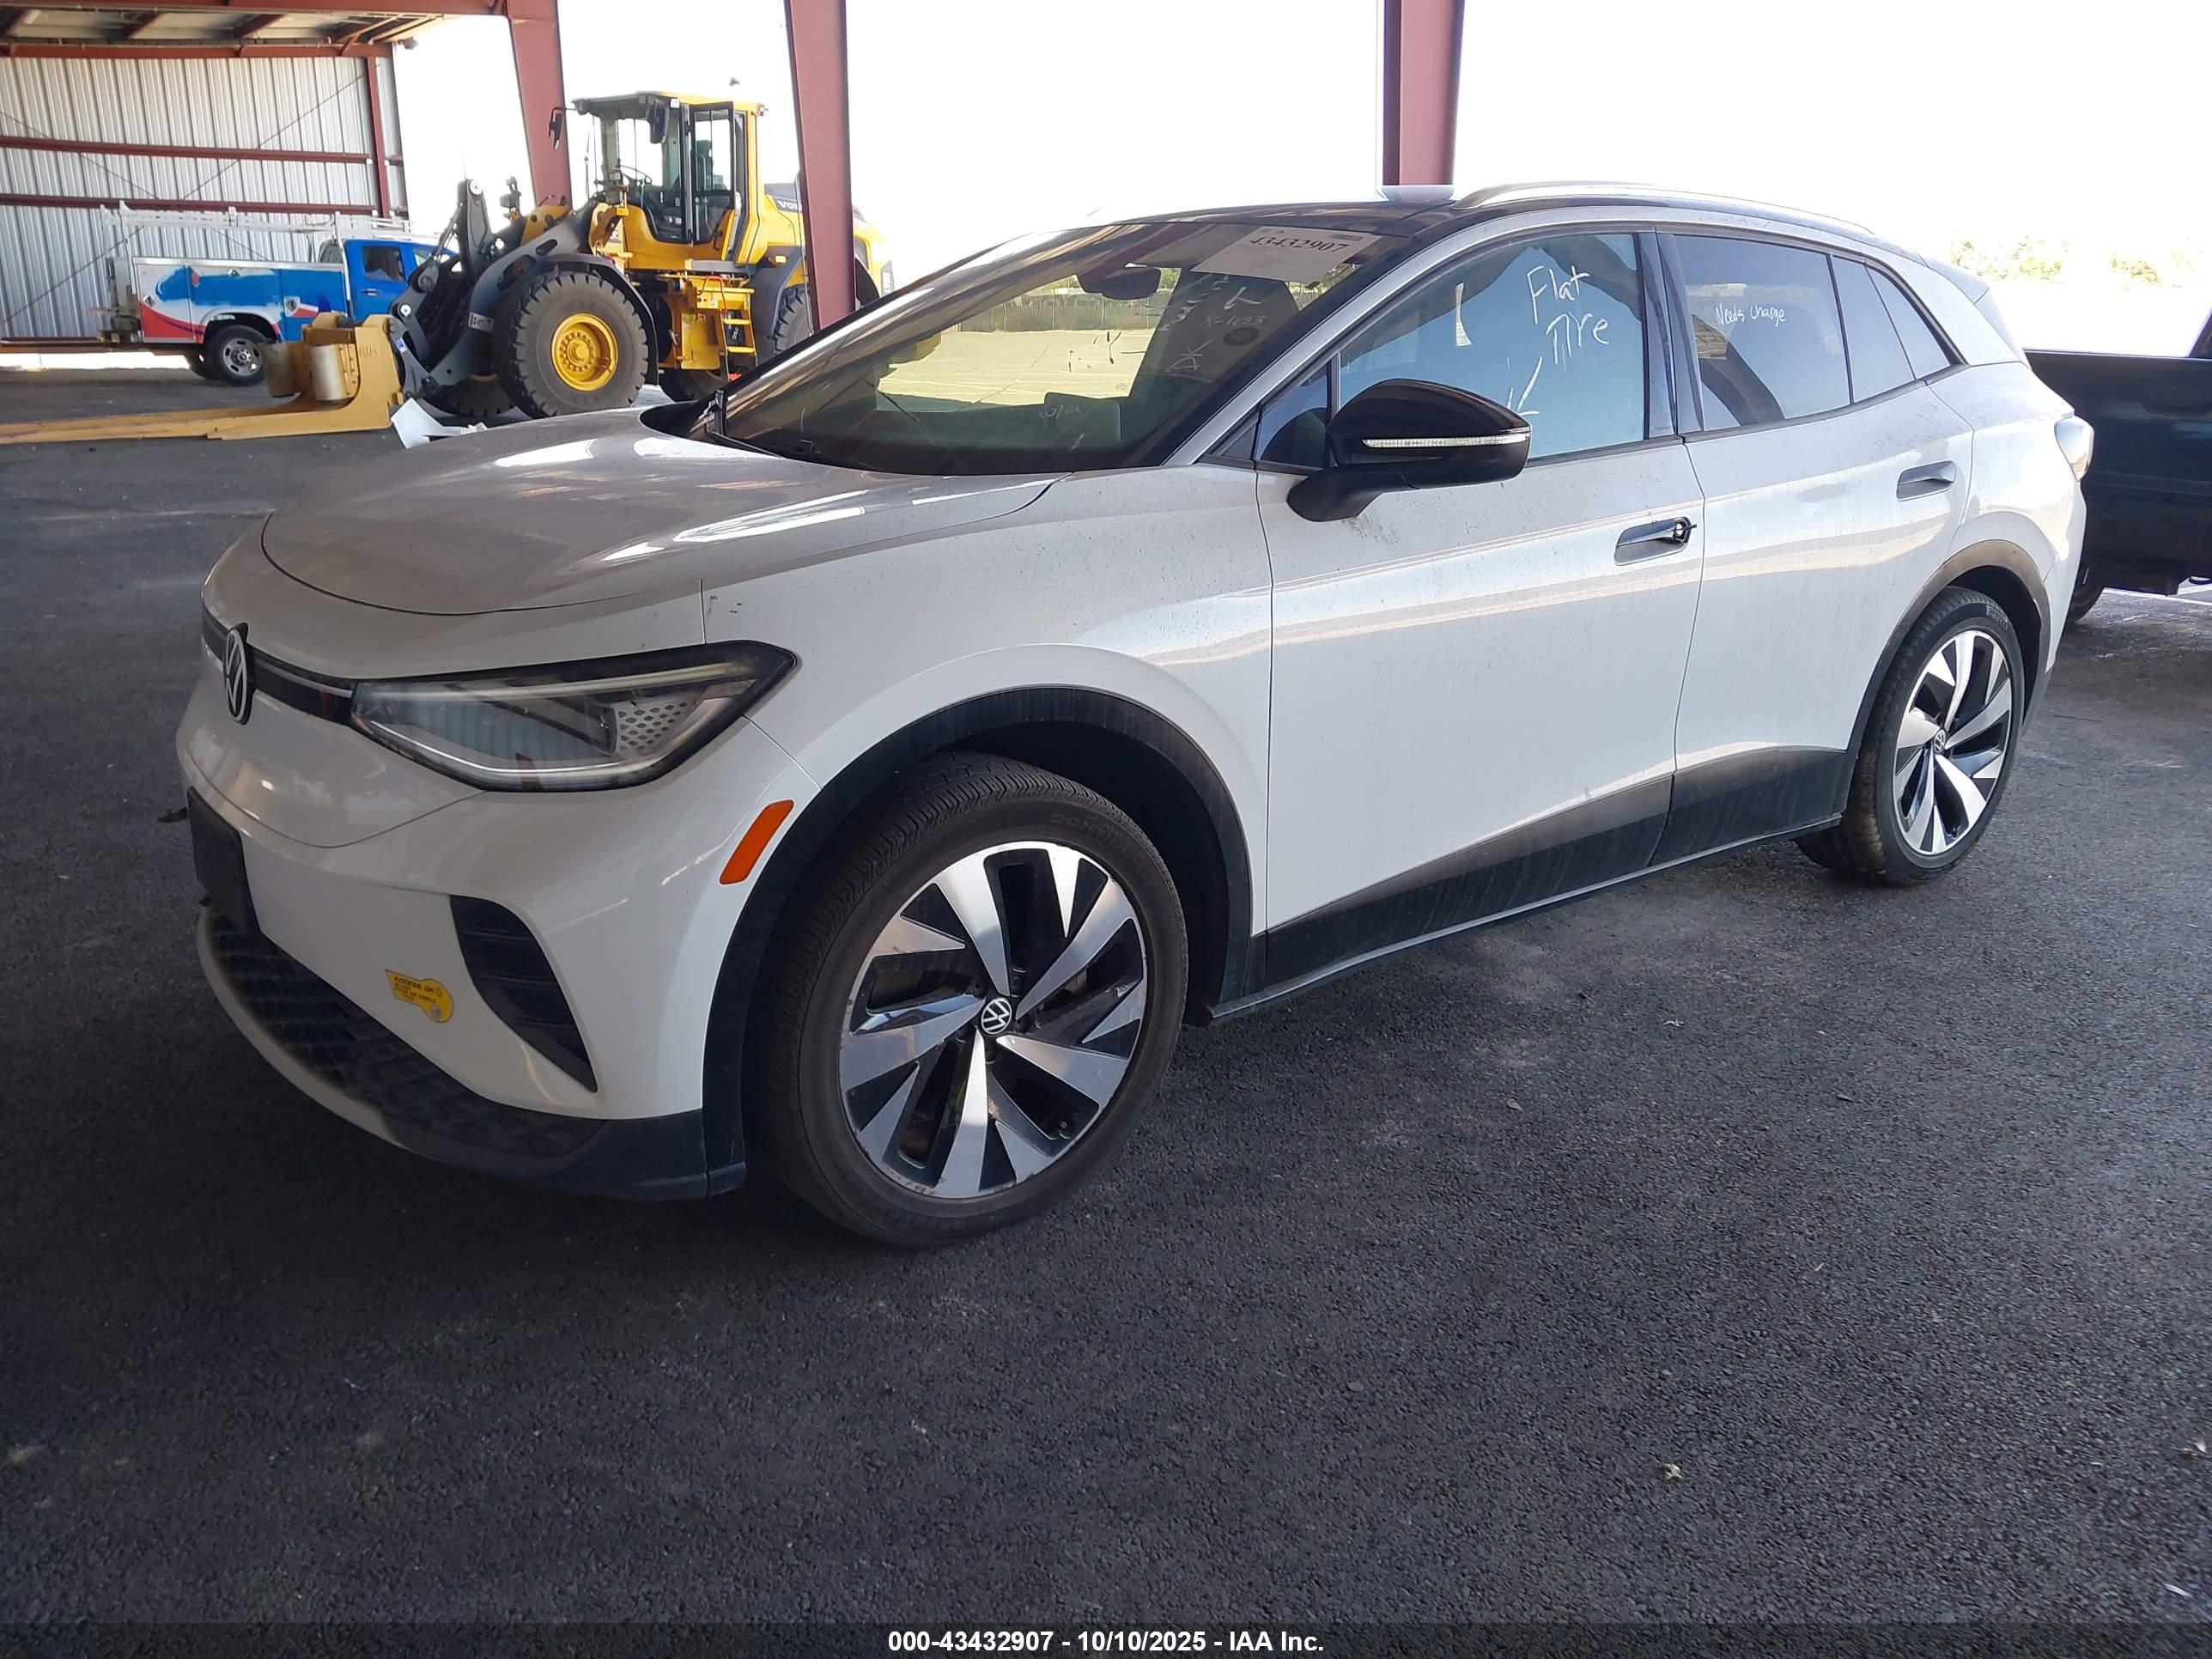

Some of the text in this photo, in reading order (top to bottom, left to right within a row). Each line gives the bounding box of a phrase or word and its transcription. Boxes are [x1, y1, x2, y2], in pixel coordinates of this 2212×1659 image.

[1250, 236, 1349, 252] 43432907
[1526, 264, 1590, 325] Flat
[1715, 302, 1745, 325] Needs
